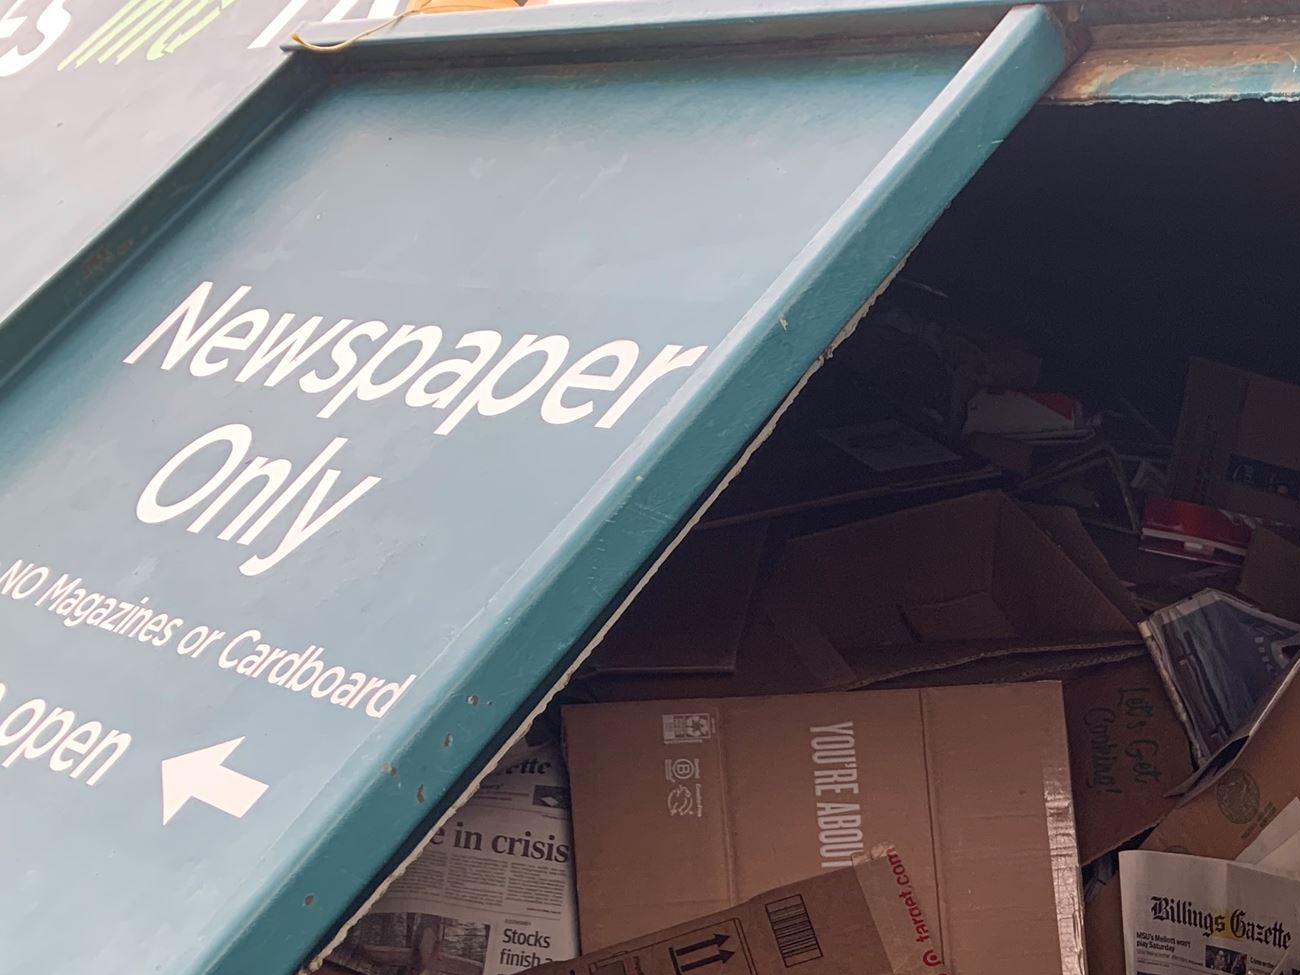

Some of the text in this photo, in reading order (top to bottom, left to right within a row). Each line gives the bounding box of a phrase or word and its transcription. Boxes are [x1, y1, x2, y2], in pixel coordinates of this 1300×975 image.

[124, 281, 708, 436] Newspaper
[136, 423, 381, 576] Only
[0, 559, 416, 718] NO Magazines or Cardboard
[0, 698, 132, 786] open
[454, 822, 570, 863] in crisis
[502, 928, 551, 949] Stocks
[1151, 896, 1292, 950] Billings Gazette
